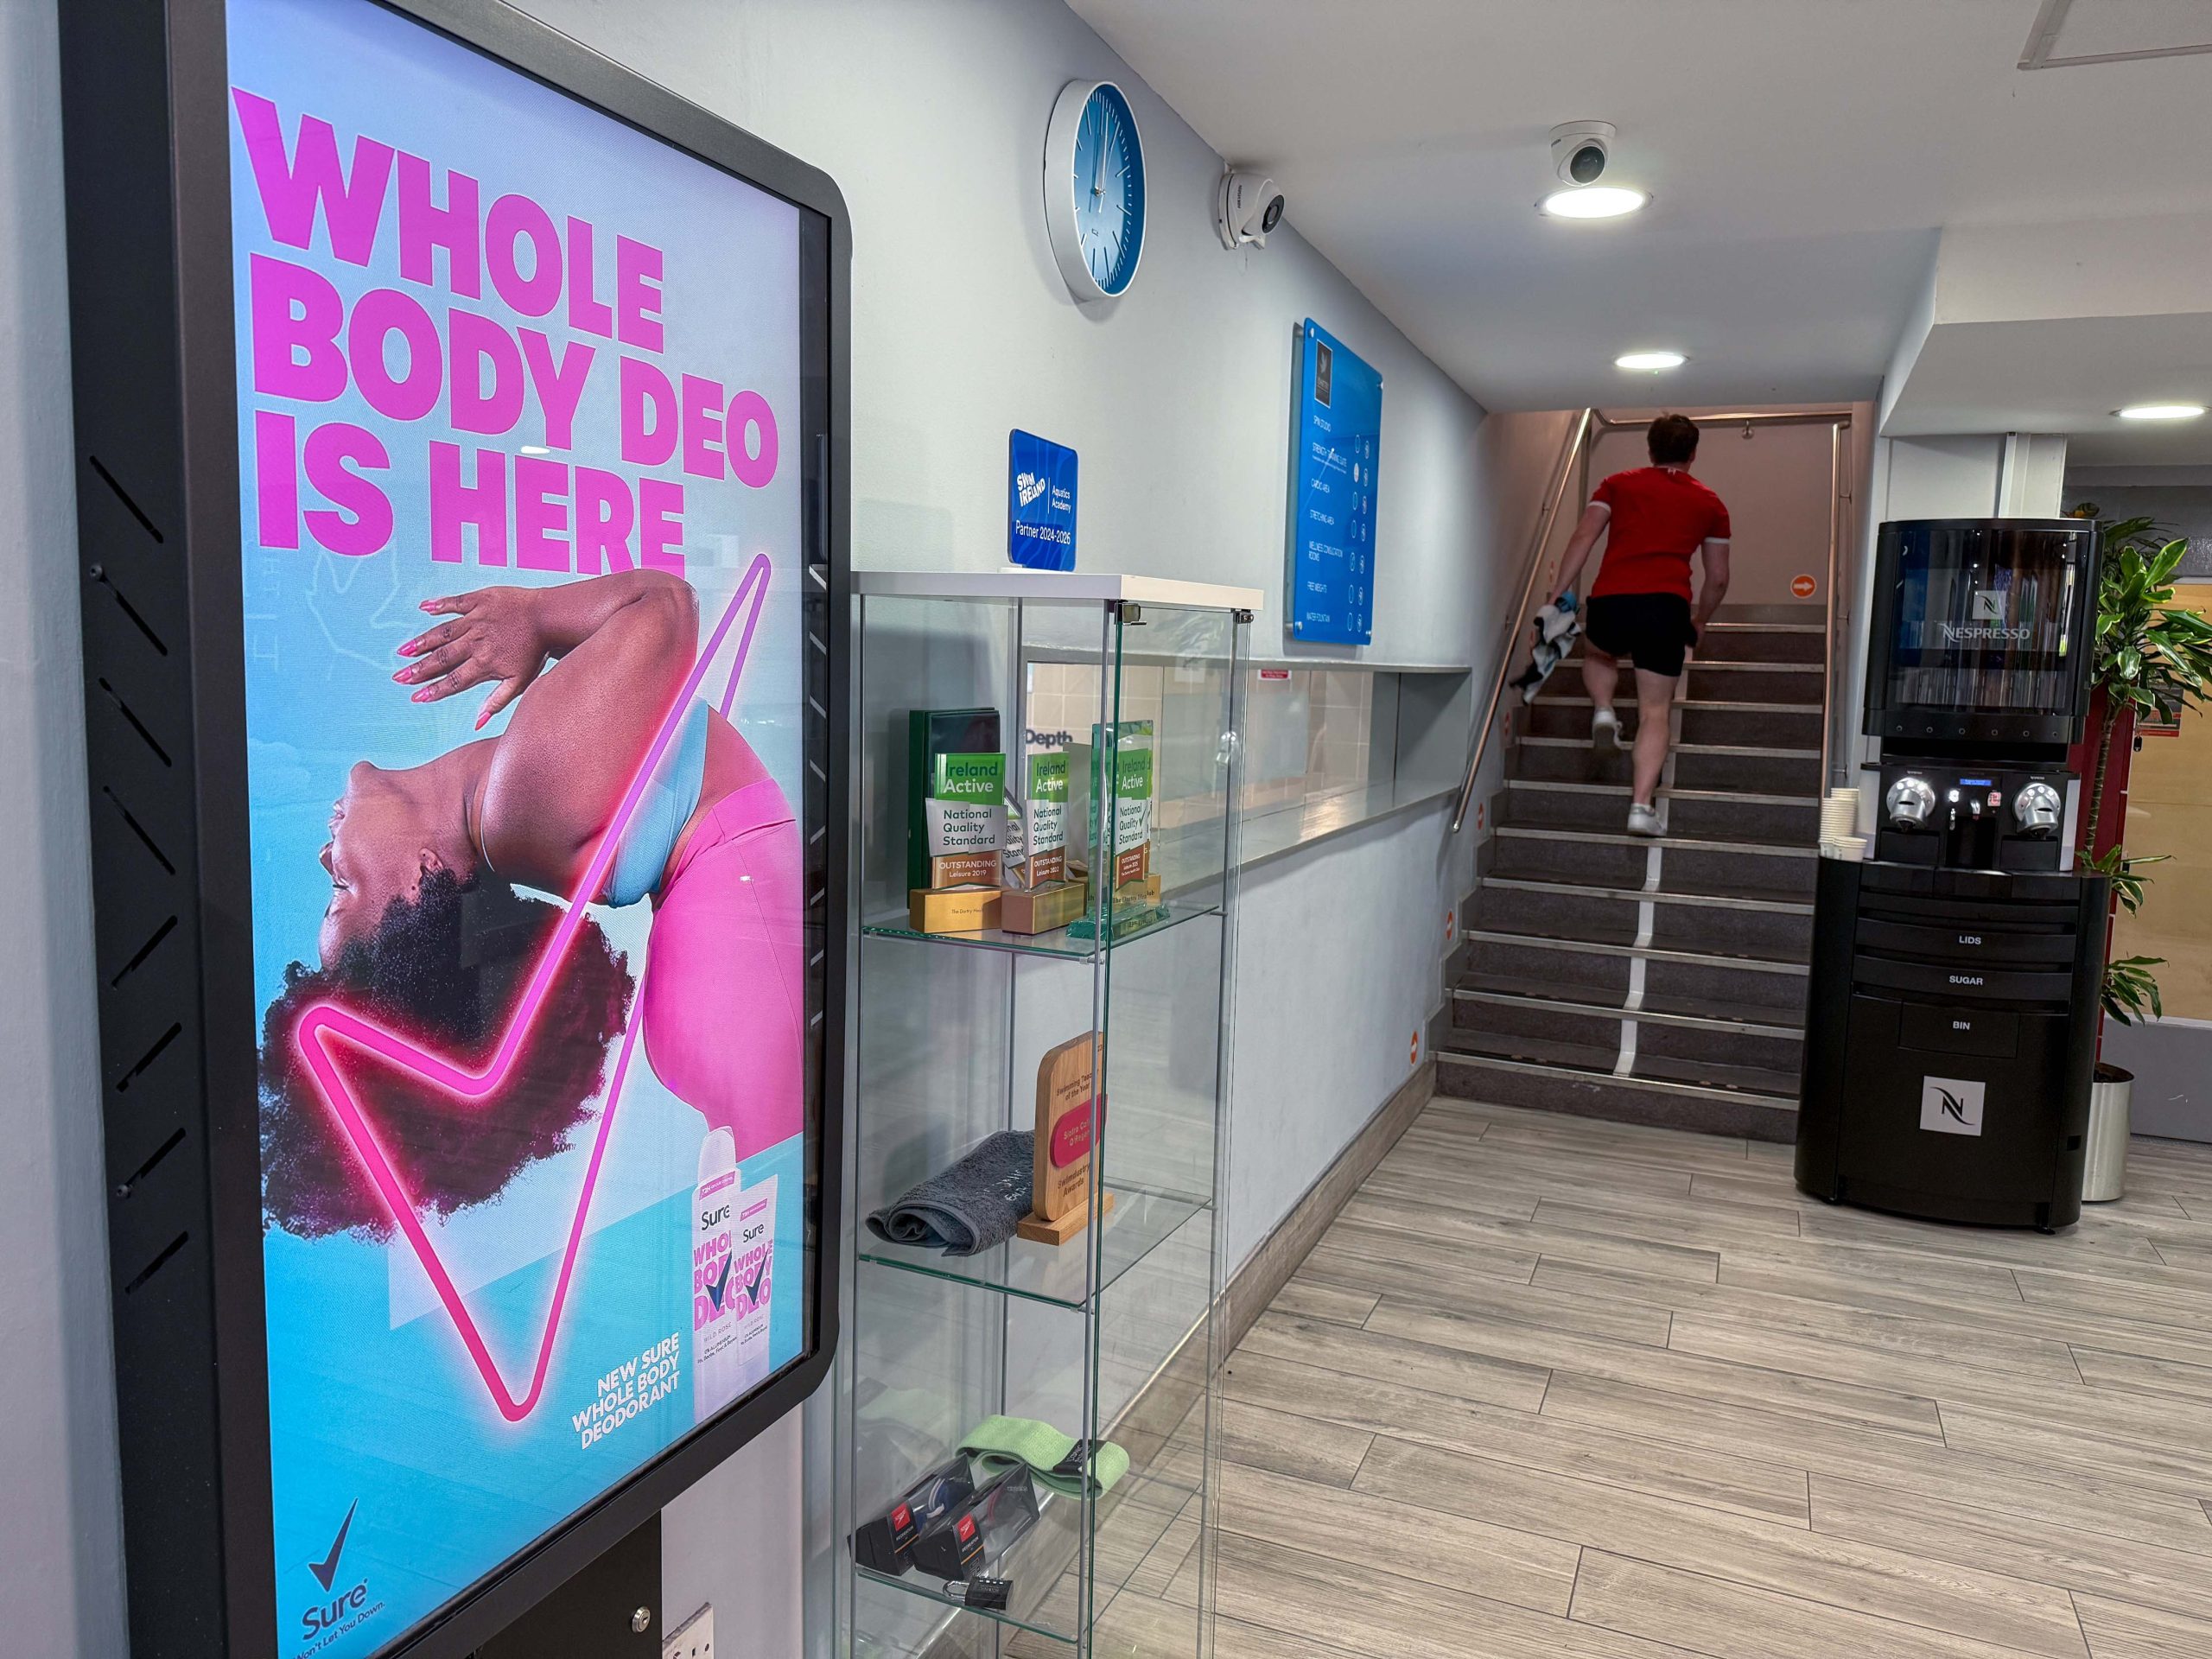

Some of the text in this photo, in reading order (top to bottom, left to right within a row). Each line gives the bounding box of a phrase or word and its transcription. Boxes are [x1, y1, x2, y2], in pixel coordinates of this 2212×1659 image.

[230, 86, 664, 354] WHOLE
[250, 252, 779, 488] BODY DEO
[255, 410, 685, 579] IS HERE
[1052, 485, 1071, 499] Aquatics
[1052, 498, 1071, 514] Academy
[1016, 519, 1071, 545] Partner 2024-2026
[1936, 622, 2031, 642] NESPRESSO
[1025, 729, 1073, 748] Depth
[945, 760, 998, 777] Ireland
[1037, 760, 1065, 776] Ireland
[1122, 756, 1146, 773] Ireland
[944, 778, 994, 793] Active
[1036, 778, 1064, 793] Active
[1122, 774, 1143, 791] Active
[944, 809, 992, 820] National
[1033, 805, 1062, 819] National
[1120, 803, 1141, 817] National
[943, 823, 985, 834] Quality
[1033, 821, 1058, 832] Quality
[1120, 817, 1139, 830] Quality
[943, 835, 995, 846] Standard
[1033, 831, 1064, 846] Standard
[1119, 830, 1143, 845] Standard
[939, 860, 997, 869] OUTSTANDING
[1033, 855, 1063, 868] OUTSTANDING
[1959, 935, 1981, 944] LIDS
[1949, 975, 1983, 985] SUGAR
[1953, 1020, 1970, 1031] BIN
[1057, 1079, 1080, 1096] Swimming
[1063, 1178, 1084, 1197] Awards
[702, 1205, 730, 1230] Sure
[743, 1224, 764, 1243] Sure
[734, 1239, 772, 1274] WHOLE
[597, 1332, 679, 1397] NEW SURE
[572, 1351, 679, 1432] WHOLE BODY
[582, 1370, 680, 1450] DEODORANT
[302, 1583, 367, 1640] Sure
[323, 1630, 339, 1647] Let
[339, 1620, 356, 1635] You
[358, 1602, 385, 1624] Down.
